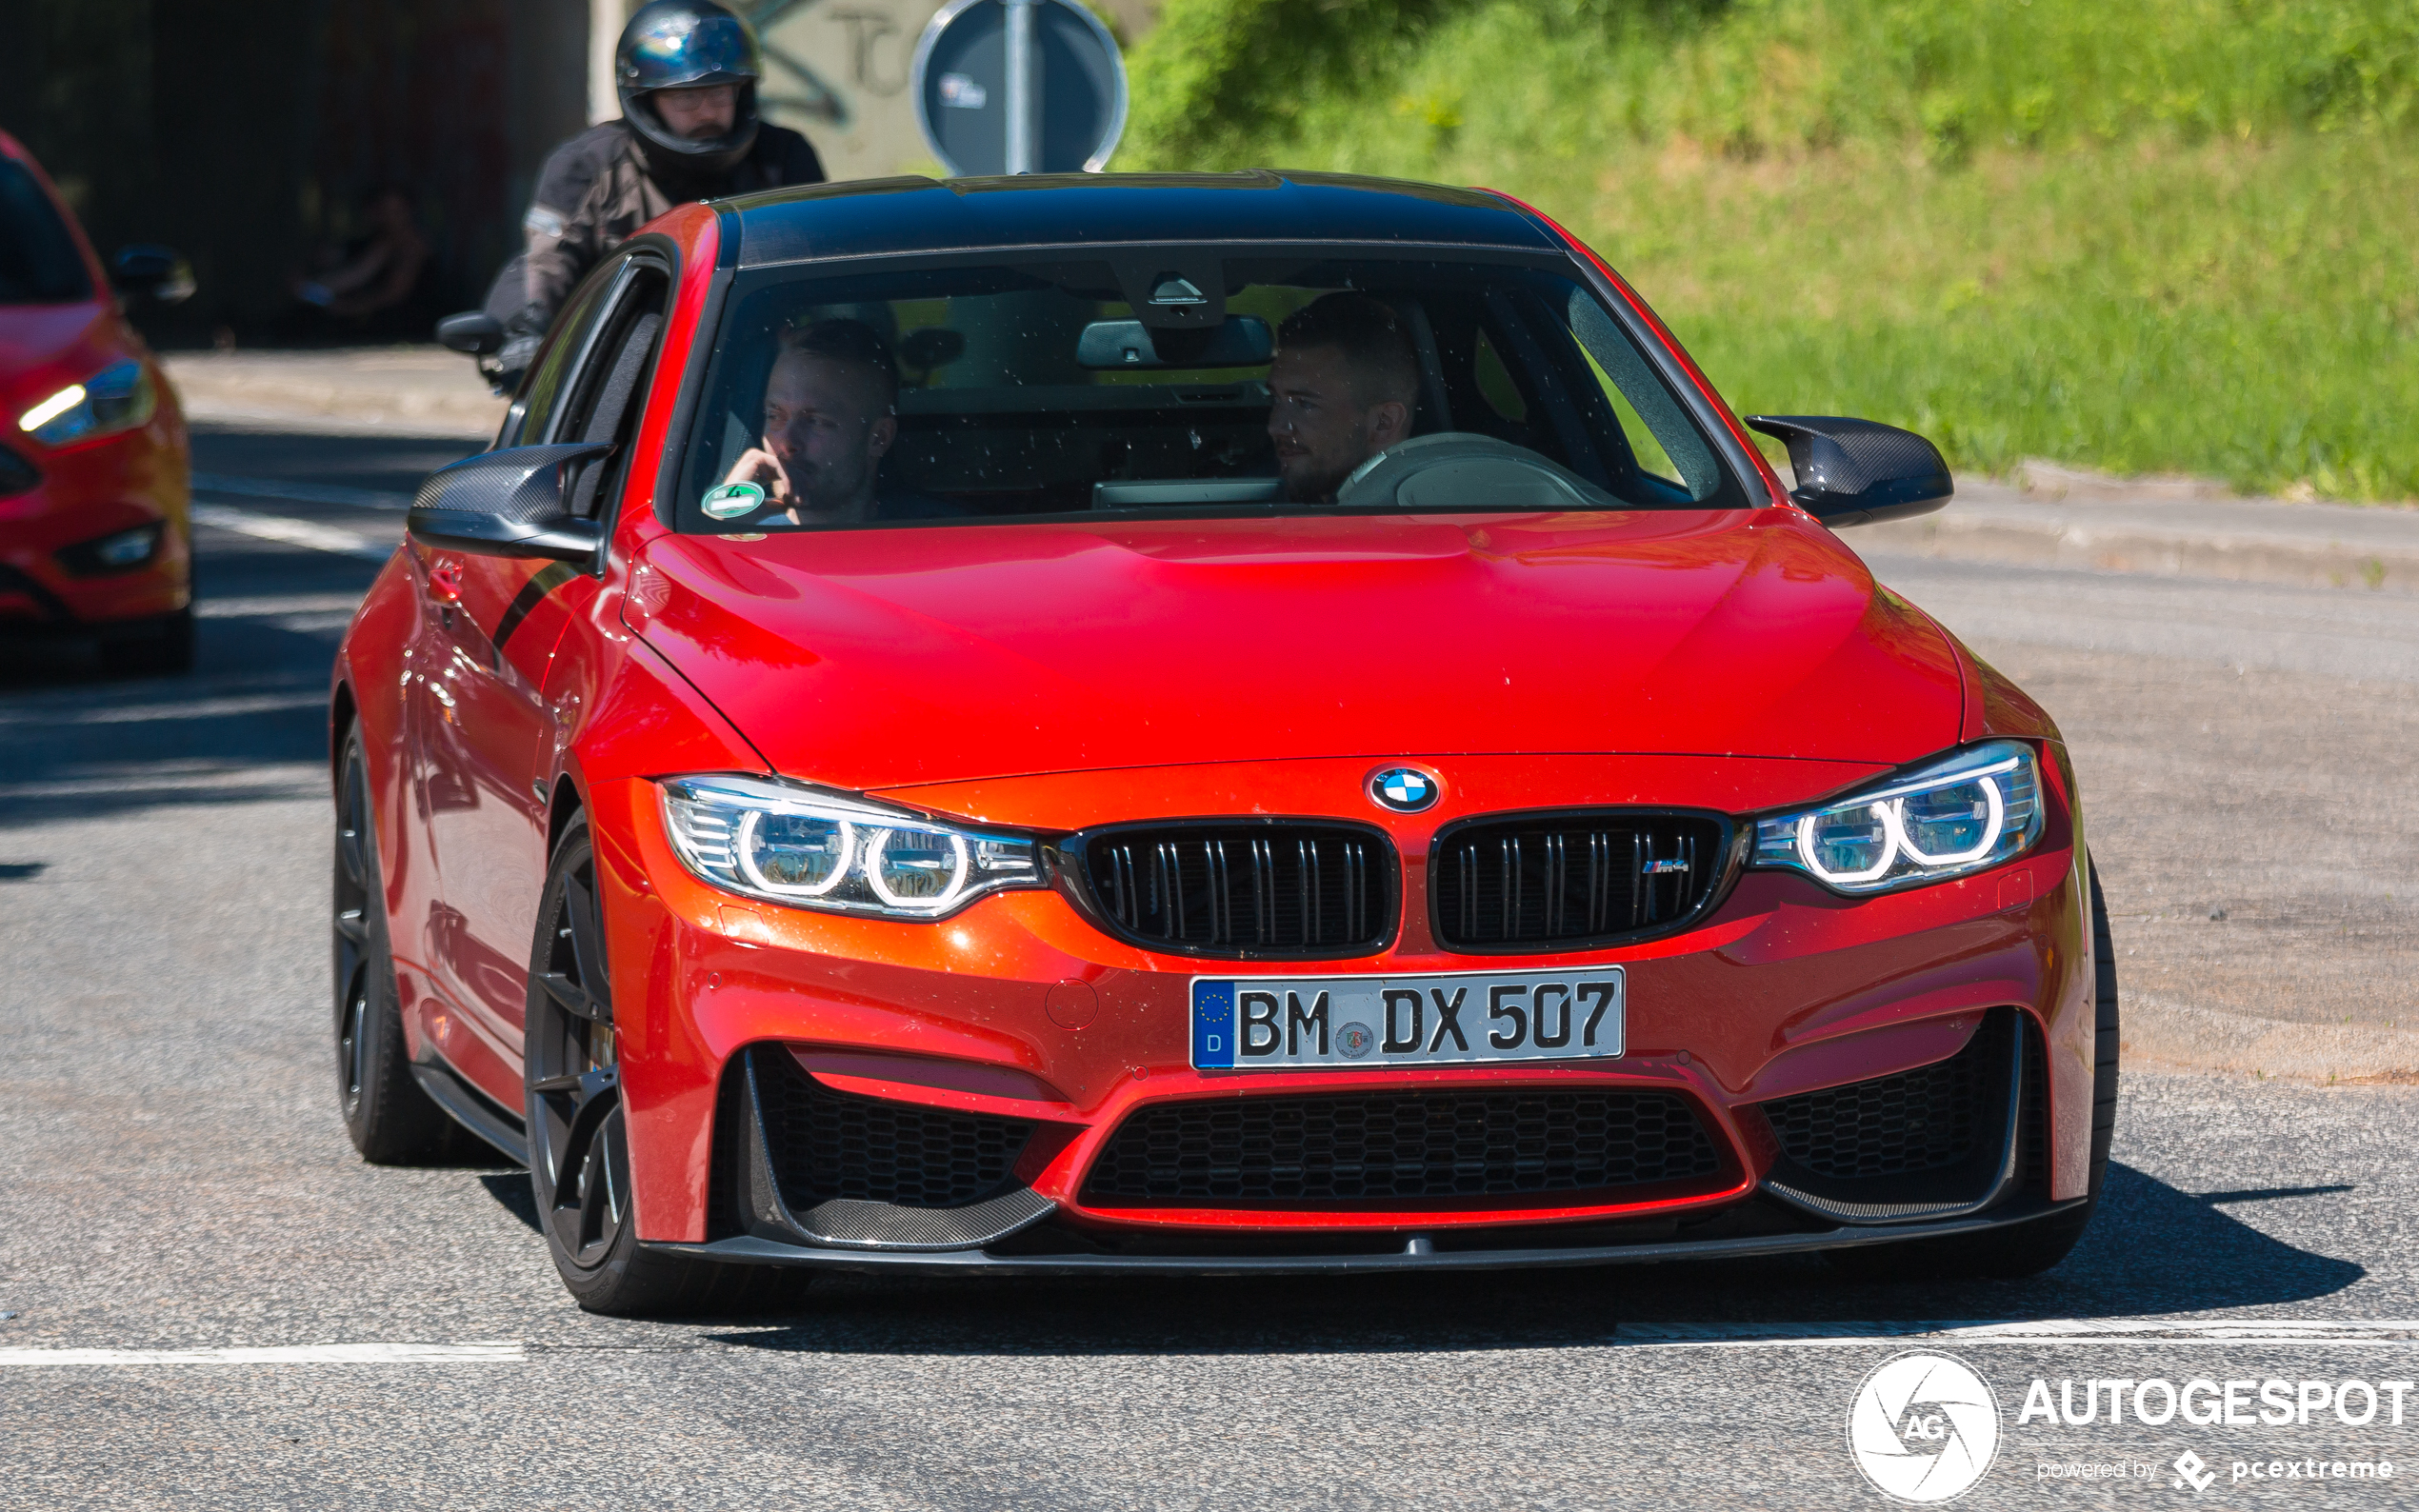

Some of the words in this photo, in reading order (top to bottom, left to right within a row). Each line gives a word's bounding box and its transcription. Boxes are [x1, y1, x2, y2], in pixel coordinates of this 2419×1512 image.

[1376, 768, 1429, 783] BMW
[1655, 859, 1689, 873] M4
[1240, 991, 1329, 1056] BM
[1383, 988, 1469, 1054] DX
[1489, 982, 1616, 1050] 507
[1208, 1035, 1221, 1052] D
